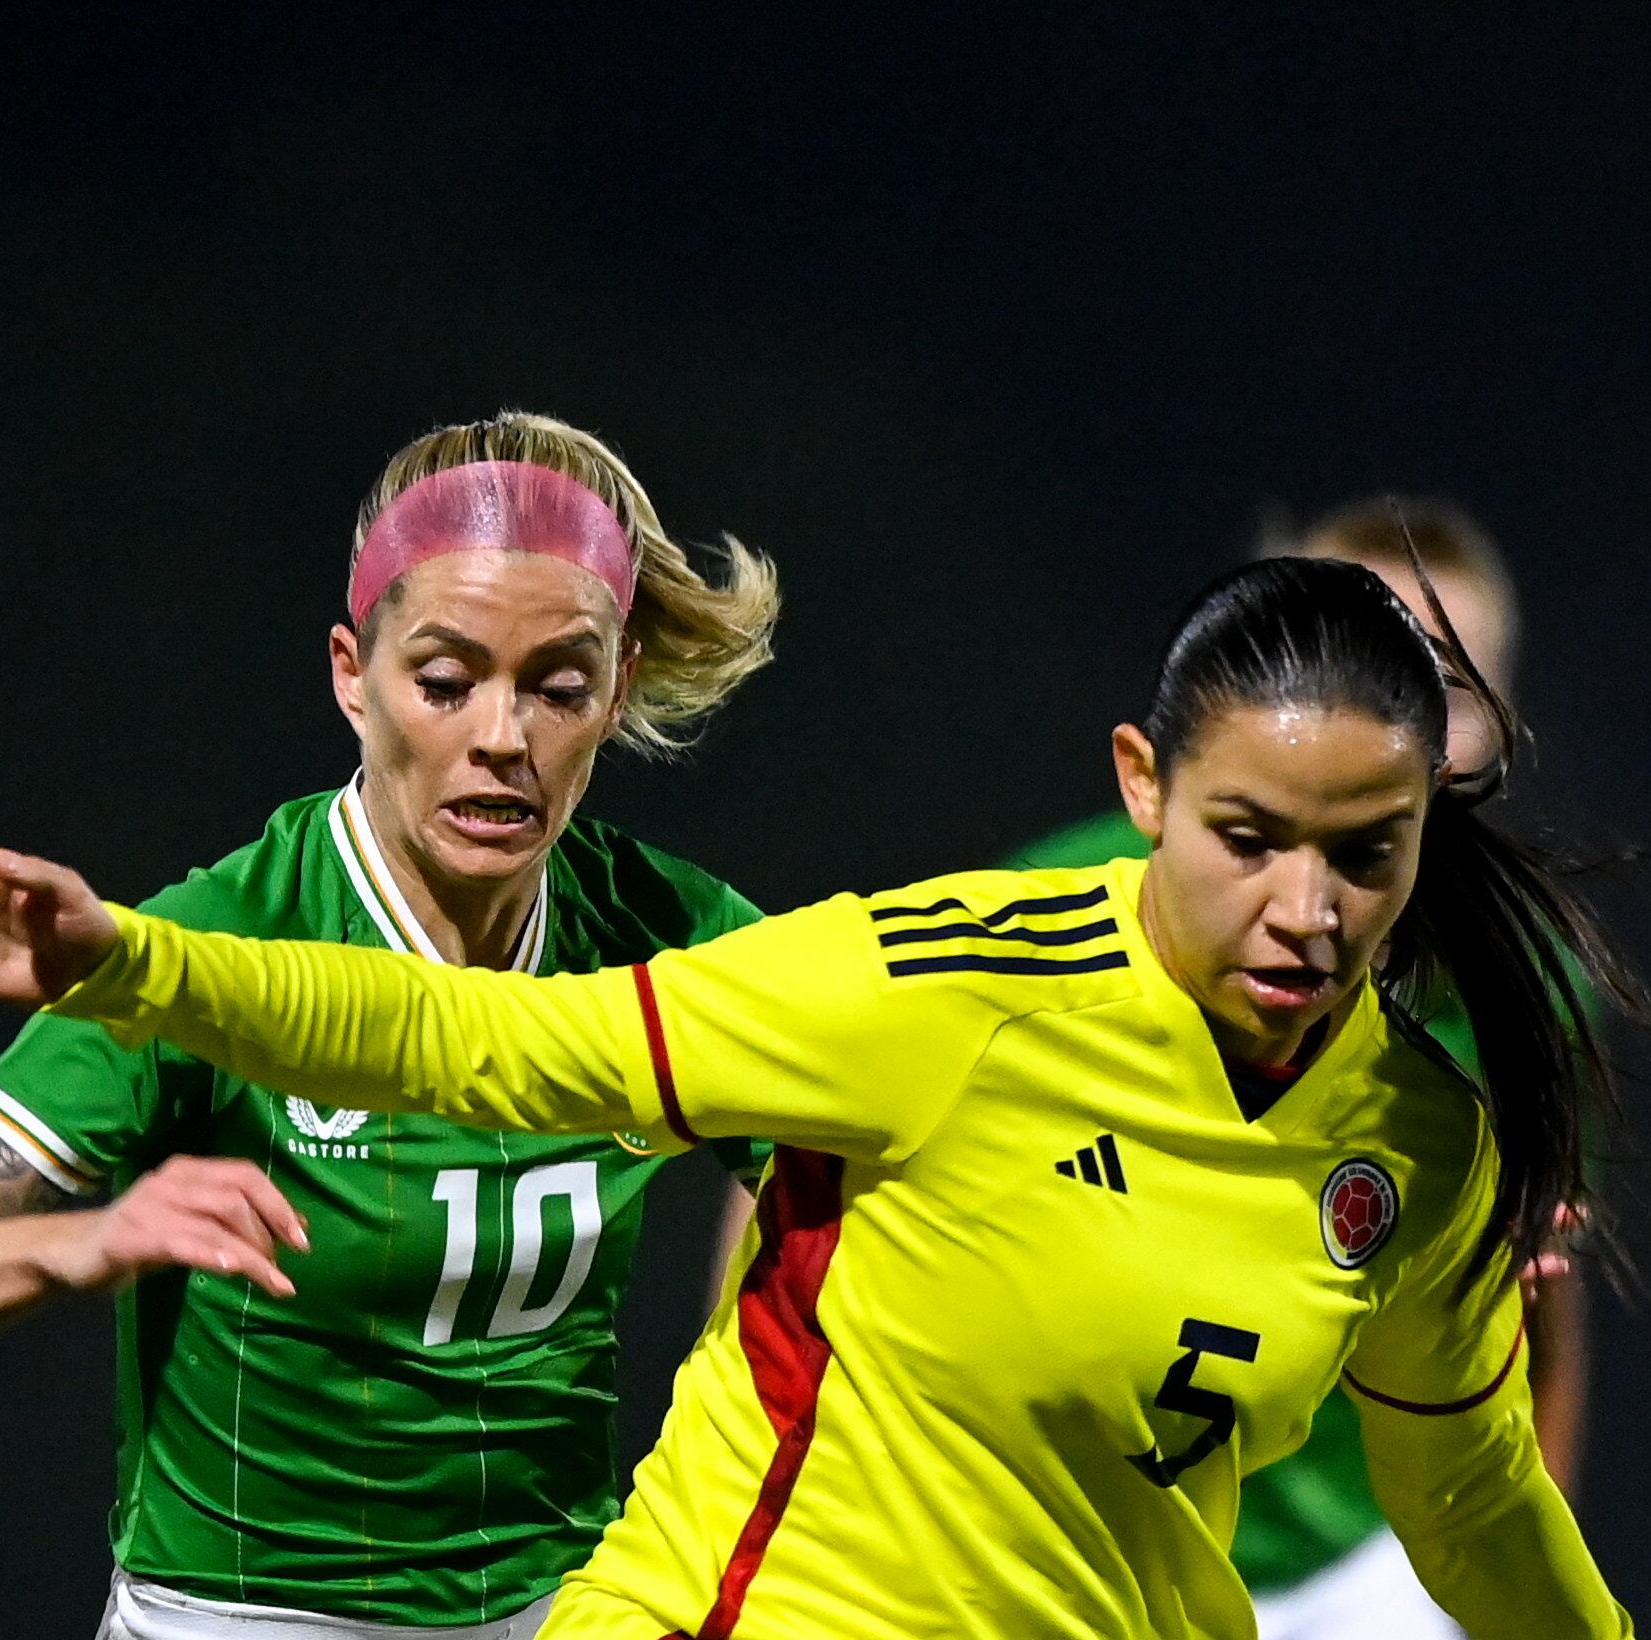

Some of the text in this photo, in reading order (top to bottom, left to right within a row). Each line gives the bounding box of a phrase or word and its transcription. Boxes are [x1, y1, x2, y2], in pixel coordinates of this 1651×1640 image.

[288, 1138, 369, 1159] CASTORE
[423, 1160, 602, 1347] 10
[1123, 1317, 1261, 1488] 5
